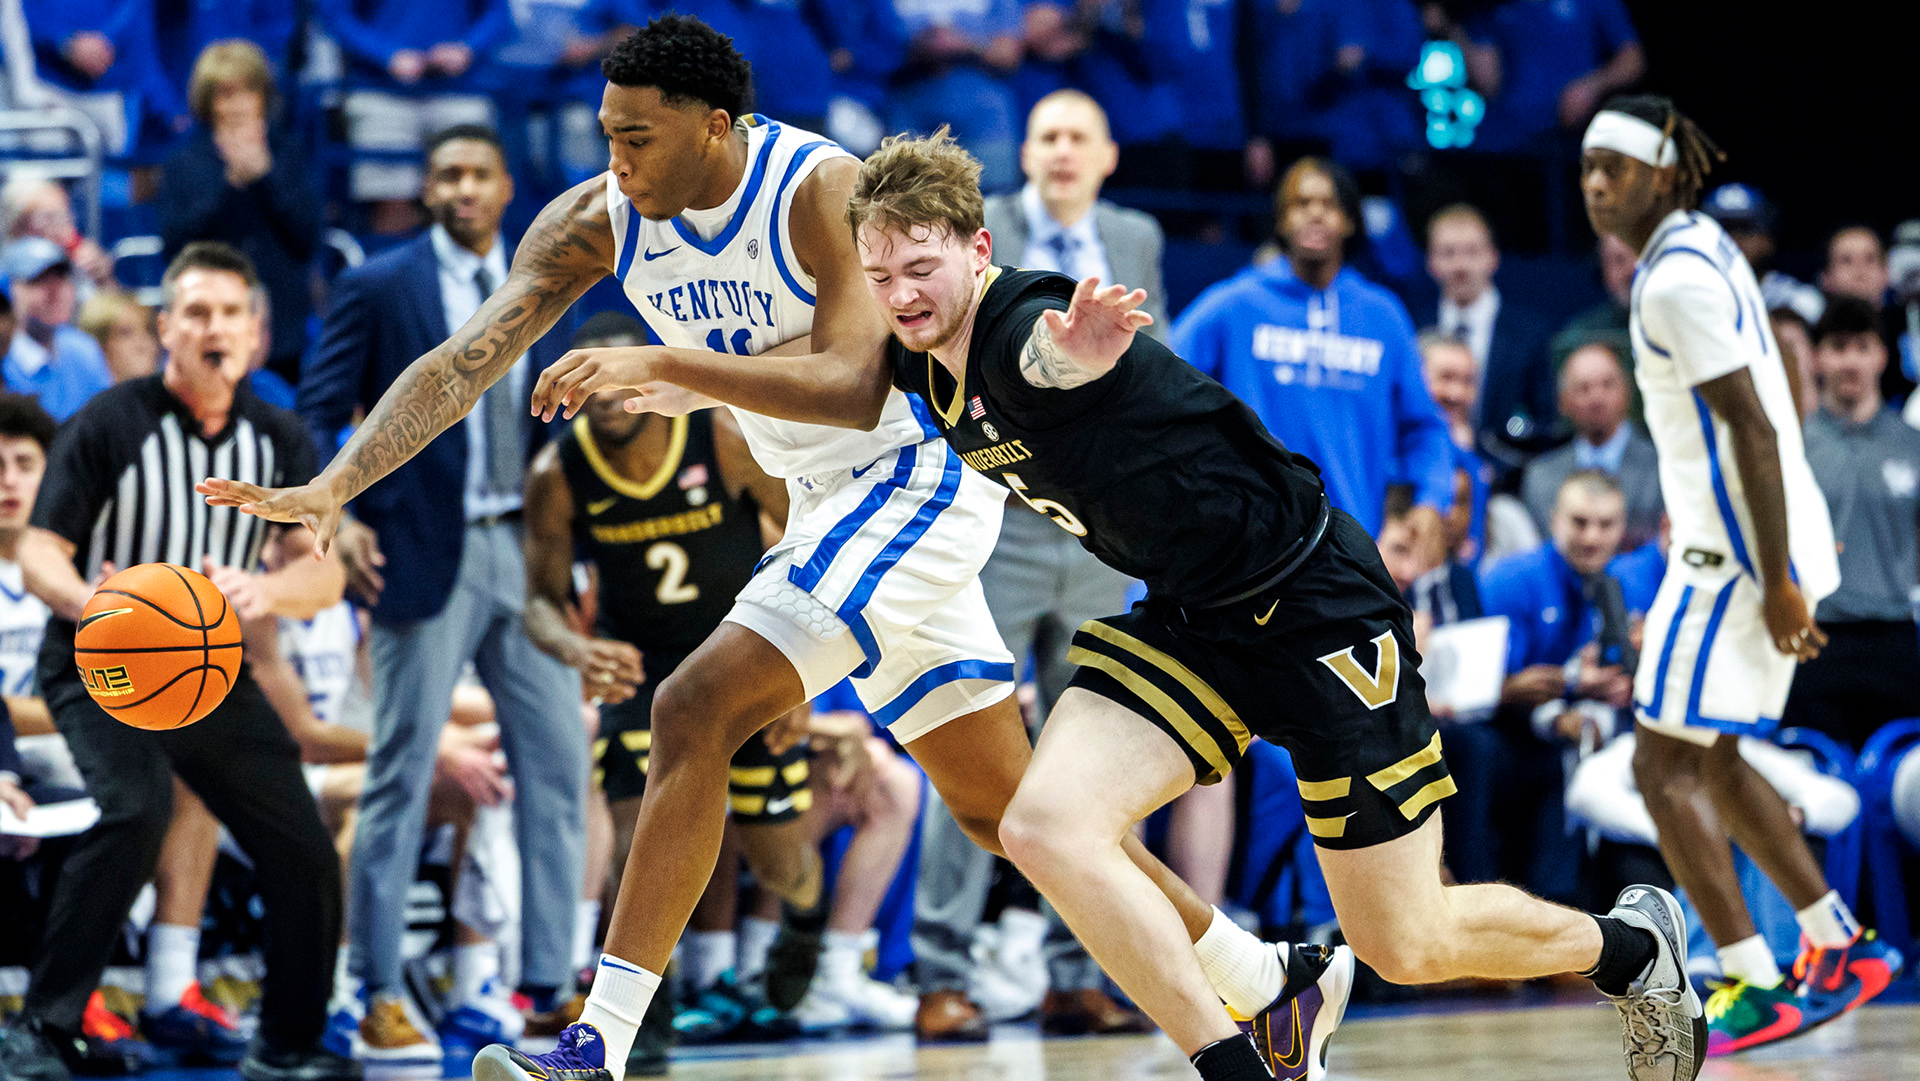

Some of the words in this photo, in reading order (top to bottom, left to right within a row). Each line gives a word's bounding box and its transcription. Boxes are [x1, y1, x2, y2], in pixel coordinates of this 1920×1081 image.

[647, 279, 775, 328] KENTUCY
[957, 439, 1033, 472] NDERBILT
[1002, 472, 1088, 537] 5
[645, 541, 699, 605] 2
[1315, 628, 1401, 711] V
